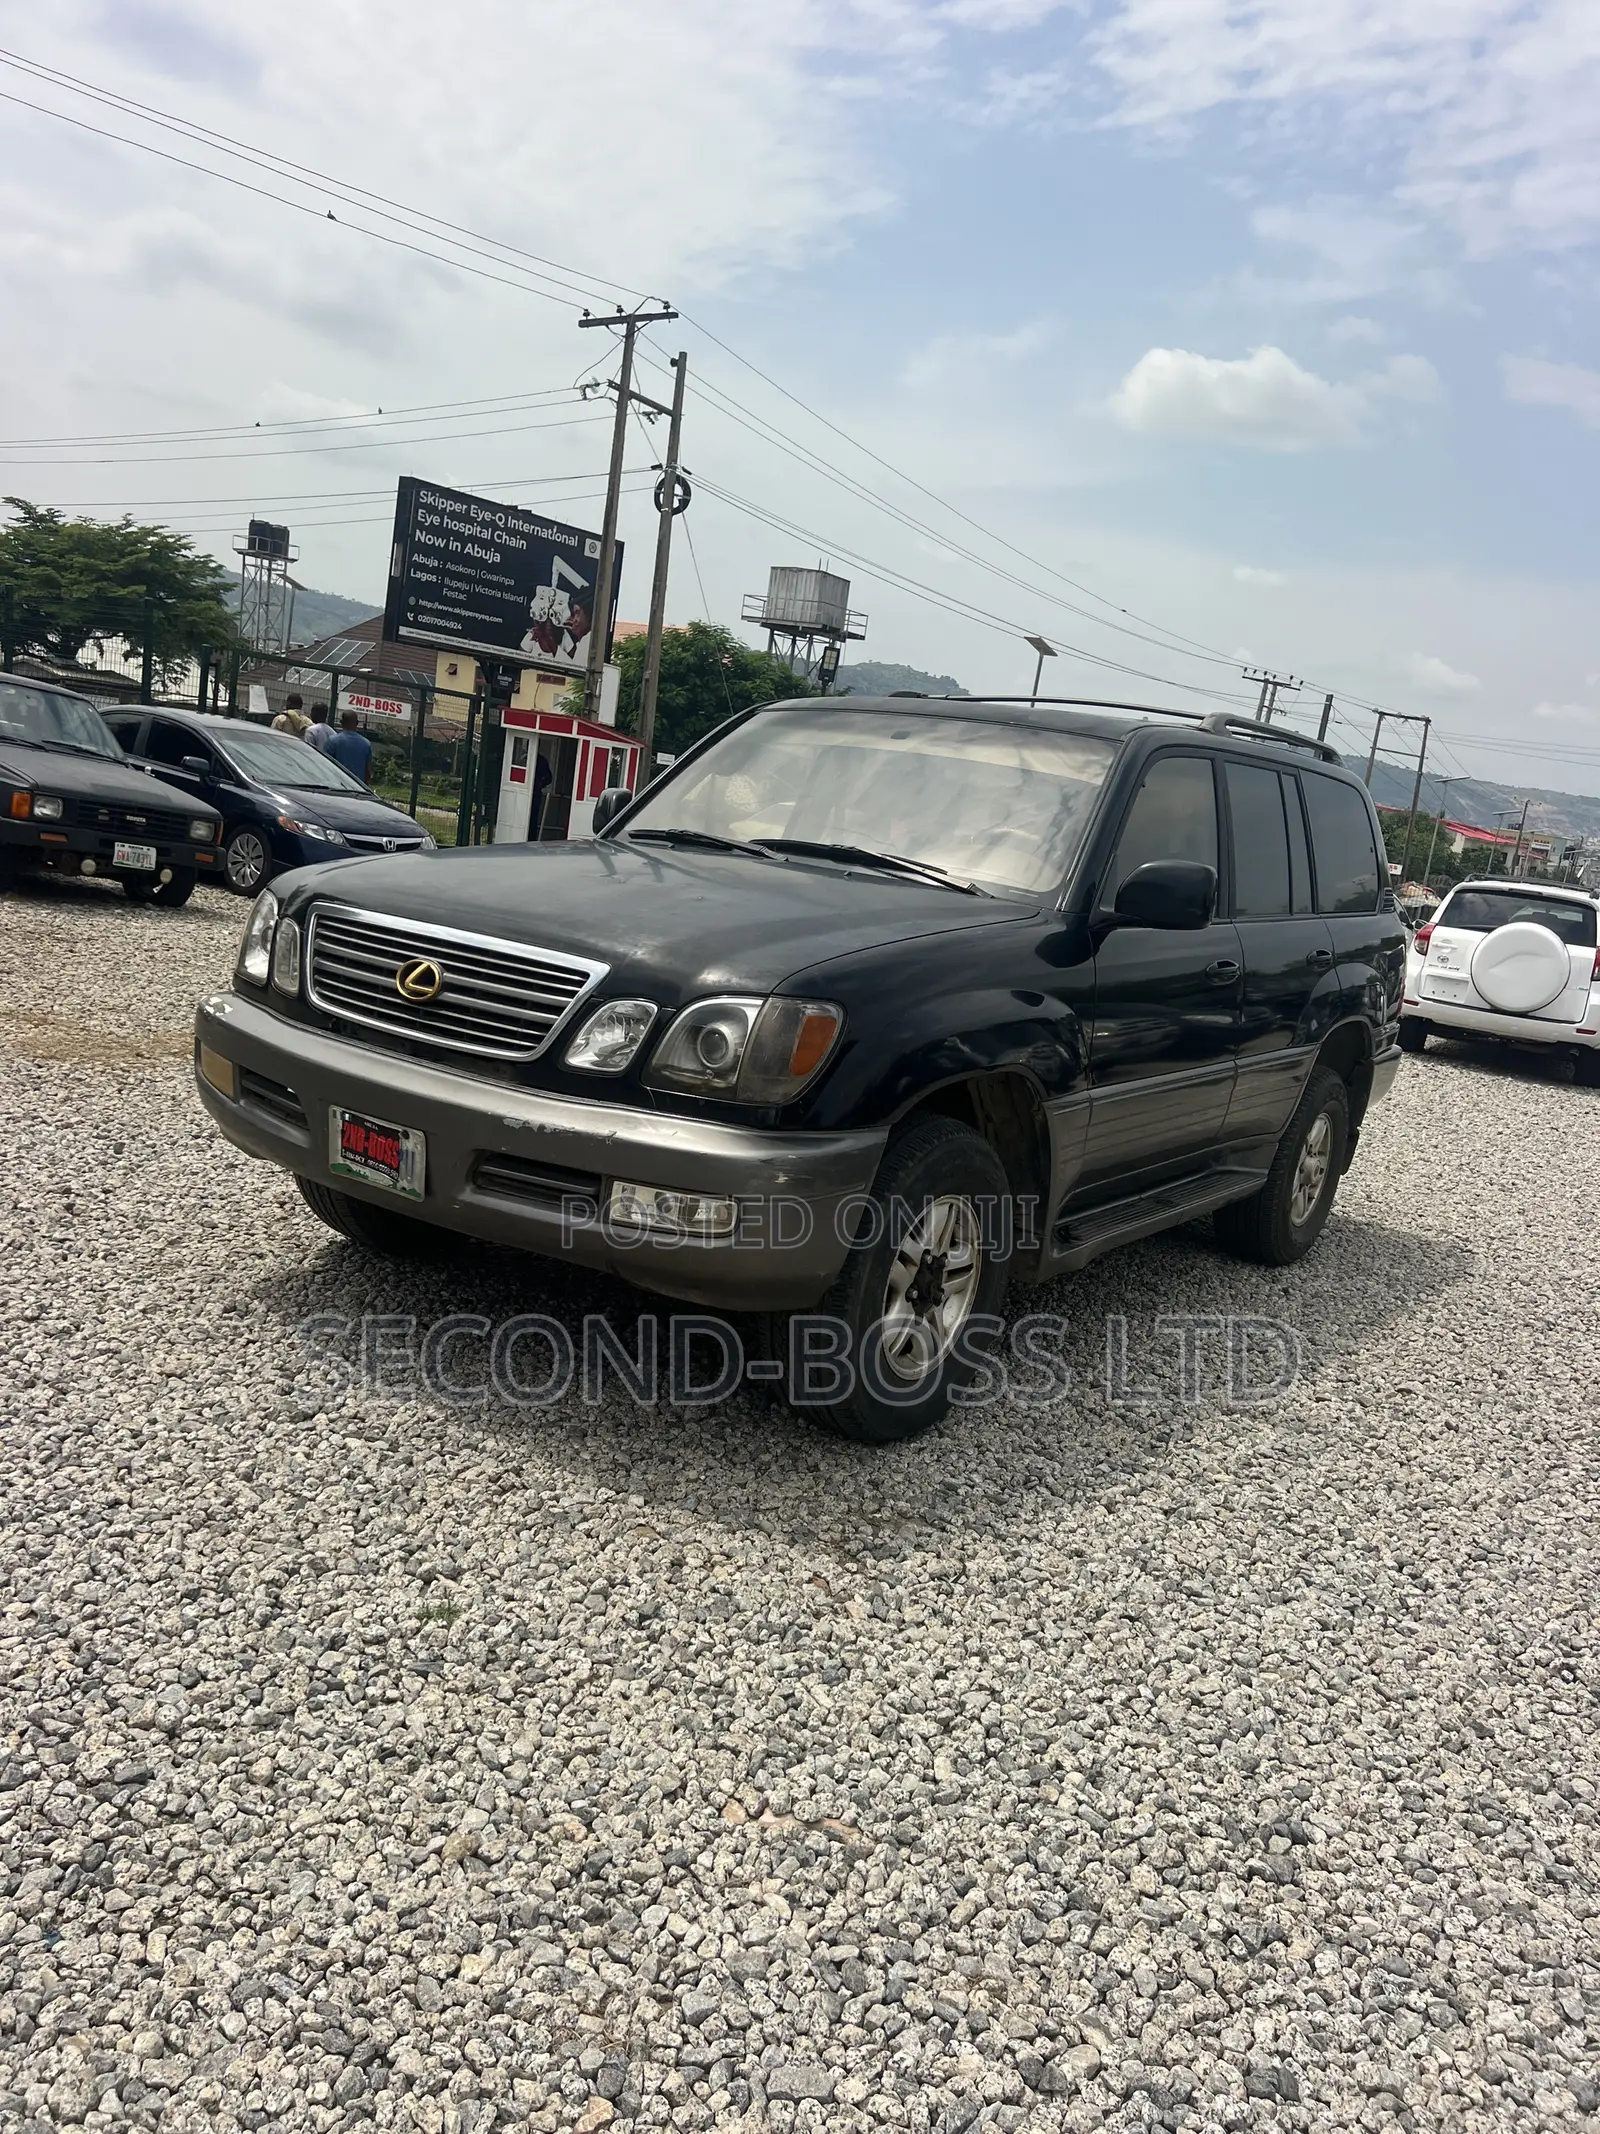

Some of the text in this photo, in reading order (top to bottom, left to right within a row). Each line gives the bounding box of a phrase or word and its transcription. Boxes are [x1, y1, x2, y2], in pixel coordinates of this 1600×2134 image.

[417, 509, 527, 550] Eye hospital Chain
[419, 490, 579, 547] Skipper Eye-Q International
[415, 529, 501, 564] Now in Abuja
[445, 561, 476, 576] Asokoro
[480, 570, 515, 586] Gwarinpa
[442, 588, 467, 601] Festac
[444, 577, 470, 590] Ilupeju
[474, 584, 502, 598] Victoria
[502, 591, 523, 603] Island
[348, 694, 403, 714] 2ND-BOSS
[342, 1122, 399, 1169] 2ND-BOSS
